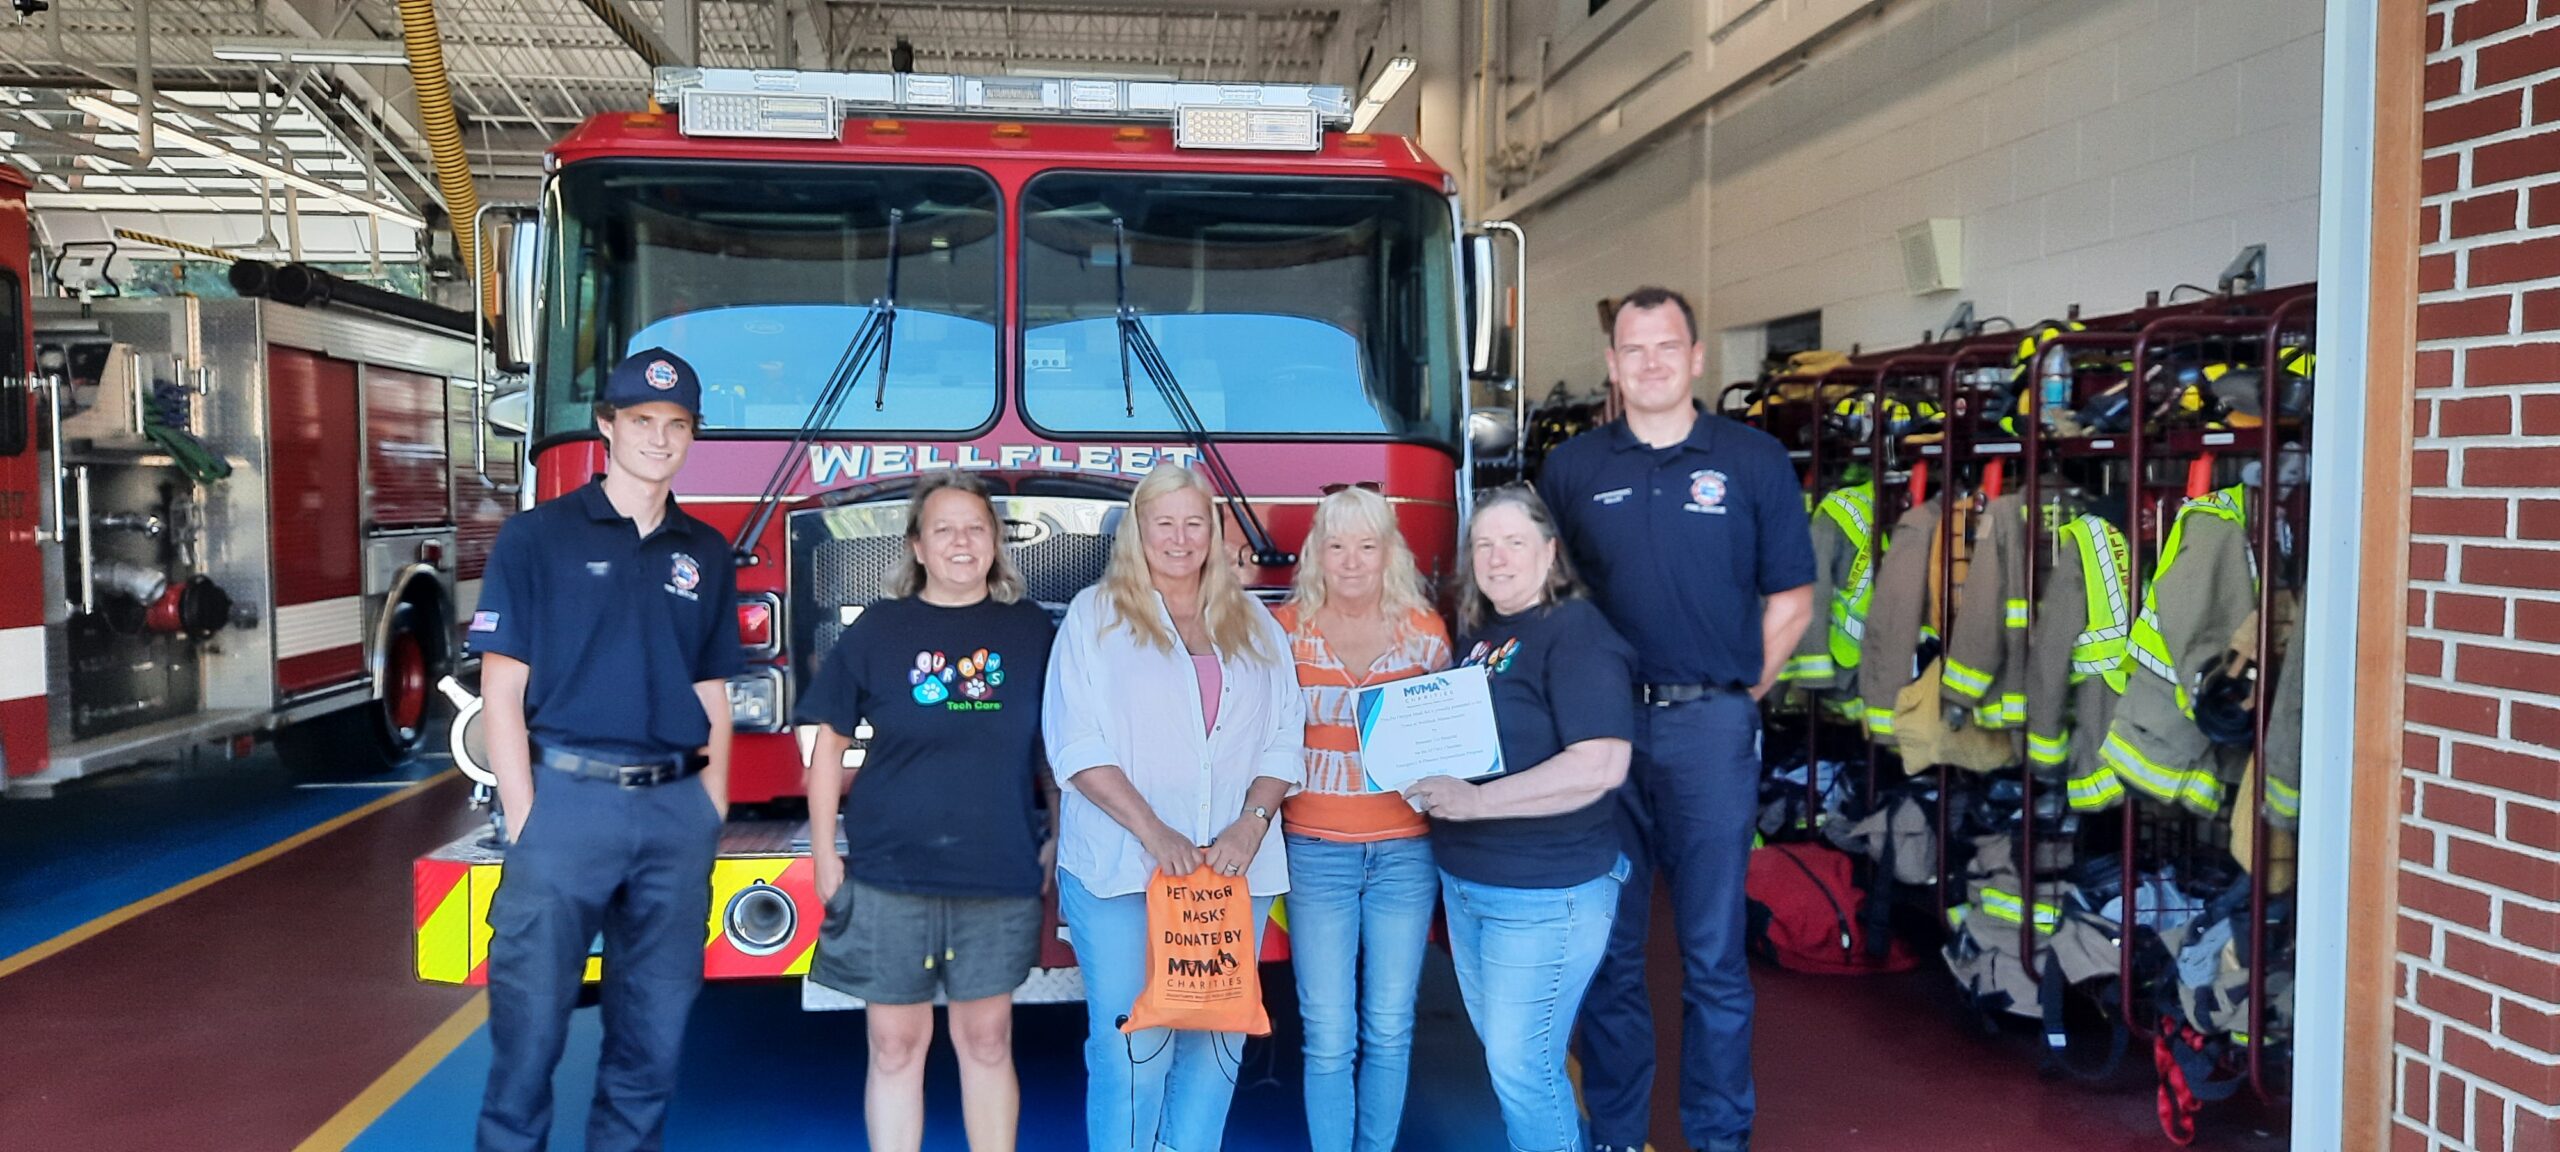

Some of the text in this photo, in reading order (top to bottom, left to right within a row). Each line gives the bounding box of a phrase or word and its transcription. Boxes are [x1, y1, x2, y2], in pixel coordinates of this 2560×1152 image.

[808, 444, 1203, 485] WELLFLEET
[909, 649, 1003, 686] FOUR PAWS
[946, 700, 1002, 711] Tech Care
[1166, 884, 1188, 900] PET
[1183, 908, 1226, 924] MASKS
[1224, 929, 1242, 944] BY
[1167, 977, 1242, 990] CHARITIES
